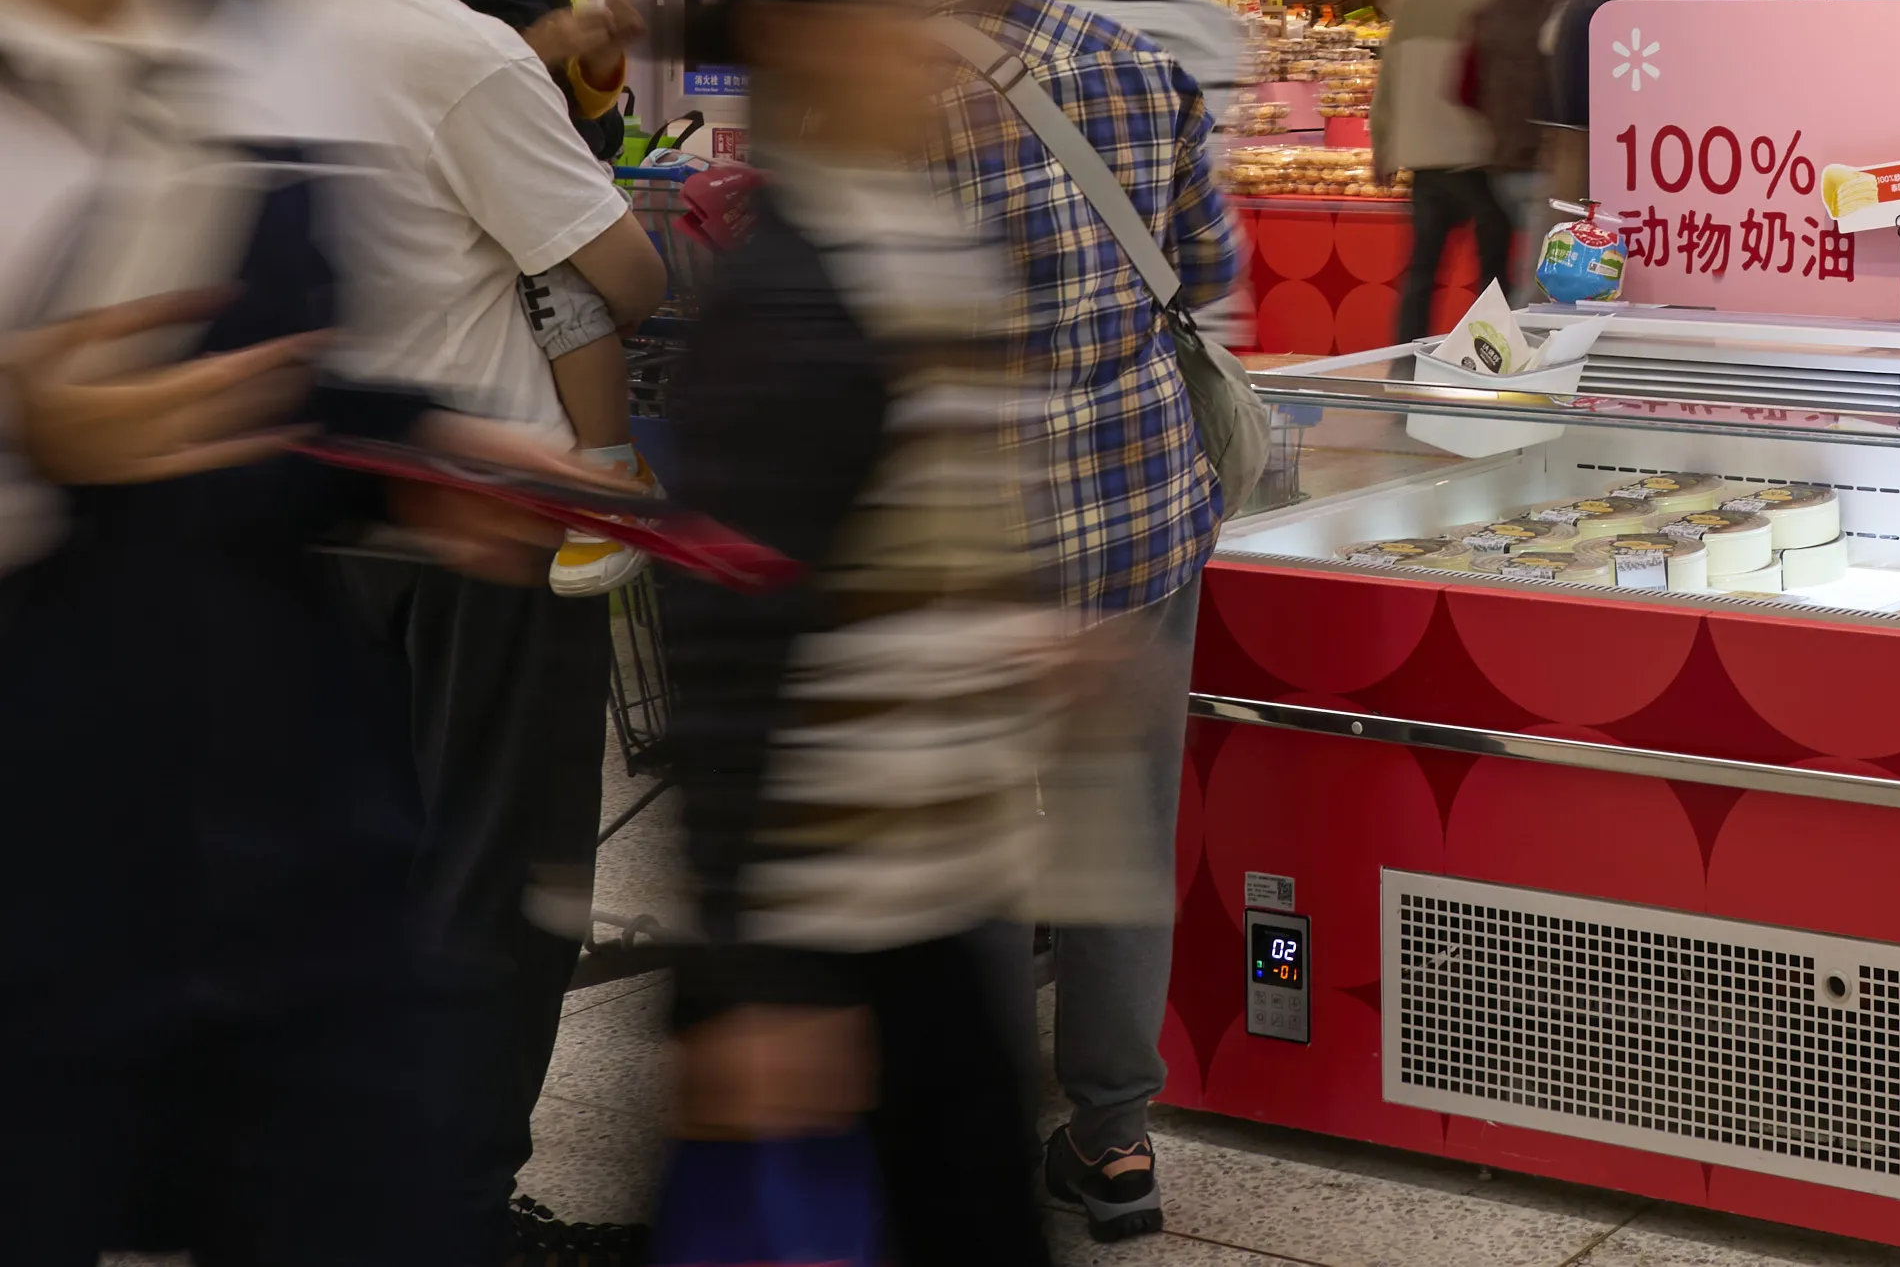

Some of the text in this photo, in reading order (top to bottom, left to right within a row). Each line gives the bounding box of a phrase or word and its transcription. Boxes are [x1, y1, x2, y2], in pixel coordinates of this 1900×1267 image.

[1616, 123, 1816, 200] 100%
[1618, 205, 1856, 283] 动物奶油
[1271, 938, 1297, 961] 02
